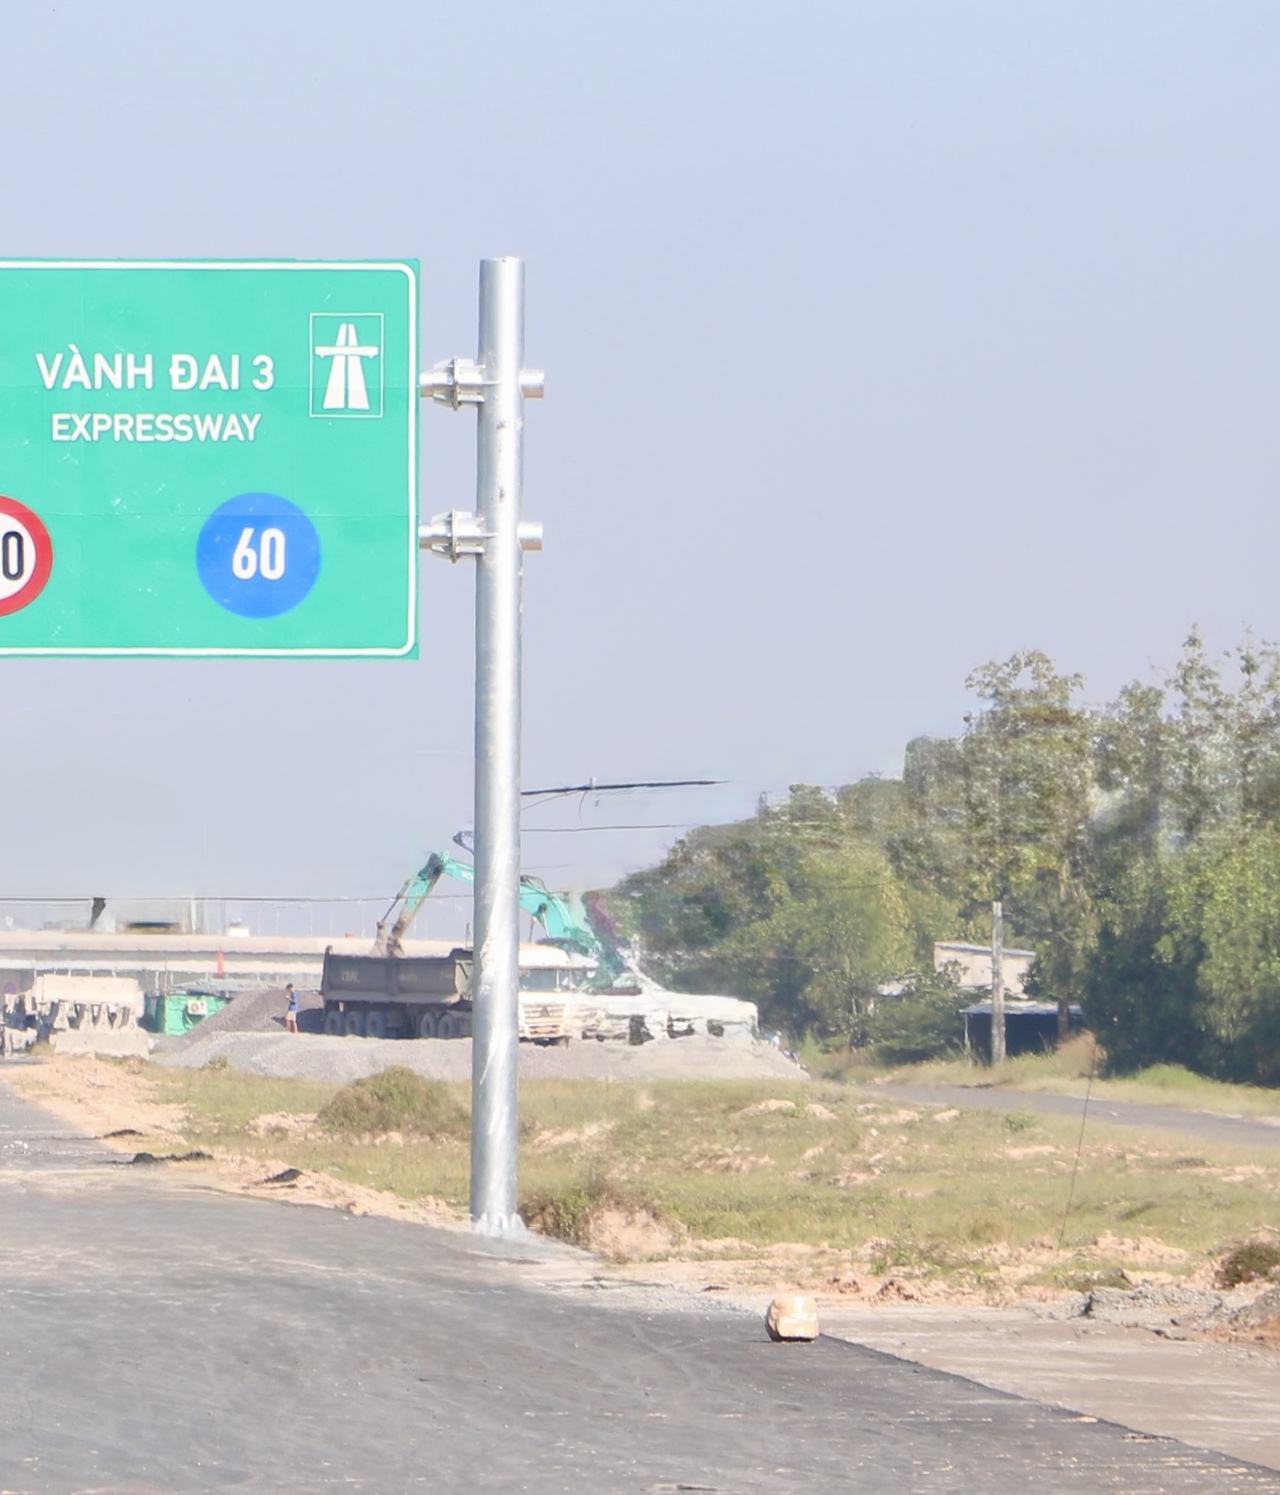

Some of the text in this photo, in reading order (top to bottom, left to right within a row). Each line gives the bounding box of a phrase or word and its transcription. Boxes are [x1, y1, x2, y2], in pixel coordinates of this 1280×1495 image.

[35, 343, 275, 391] VÀNH ĐAI 3
[51, 412, 262, 442] EXPRESSWAY
[231, 527, 286, 581] 60
